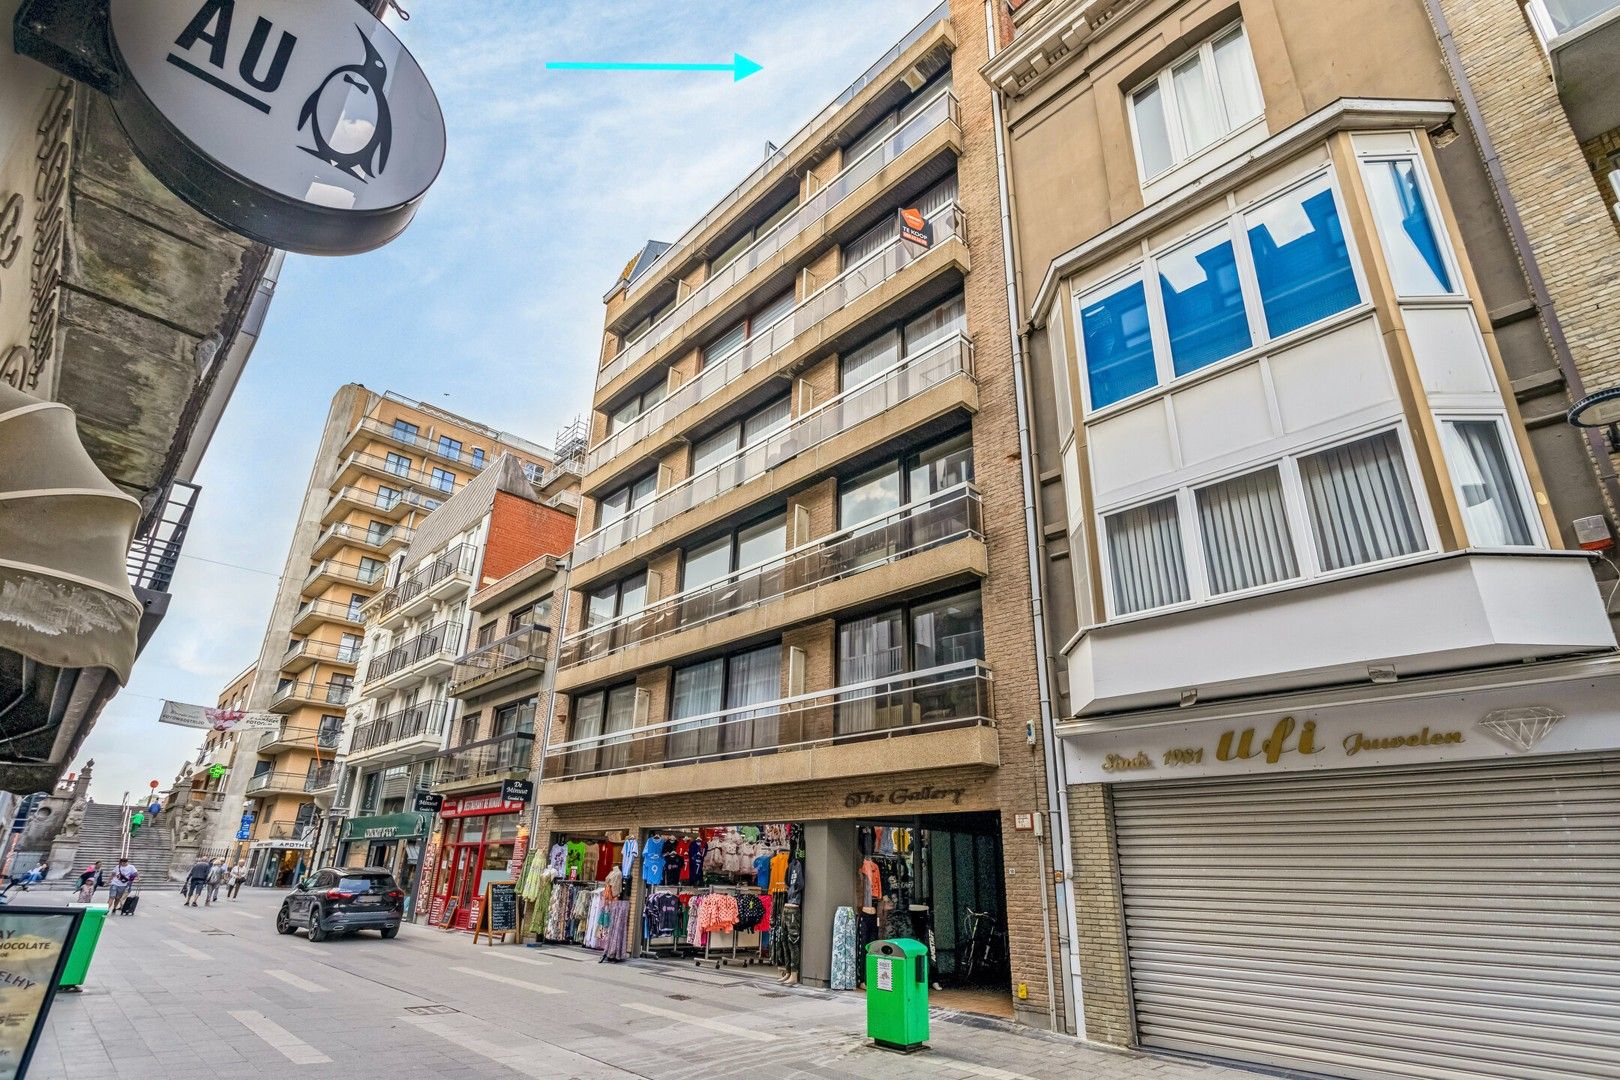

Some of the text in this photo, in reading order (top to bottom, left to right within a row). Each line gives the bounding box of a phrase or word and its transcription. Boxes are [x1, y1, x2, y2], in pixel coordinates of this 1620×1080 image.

[174, 0, 298, 93] AU
[911, 229, 928, 240] KOOP
[1343, 726, 1466, 757] Juwelen
[845, 786, 965, 808] The Gallery
[651, 864, 659, 875] 9
